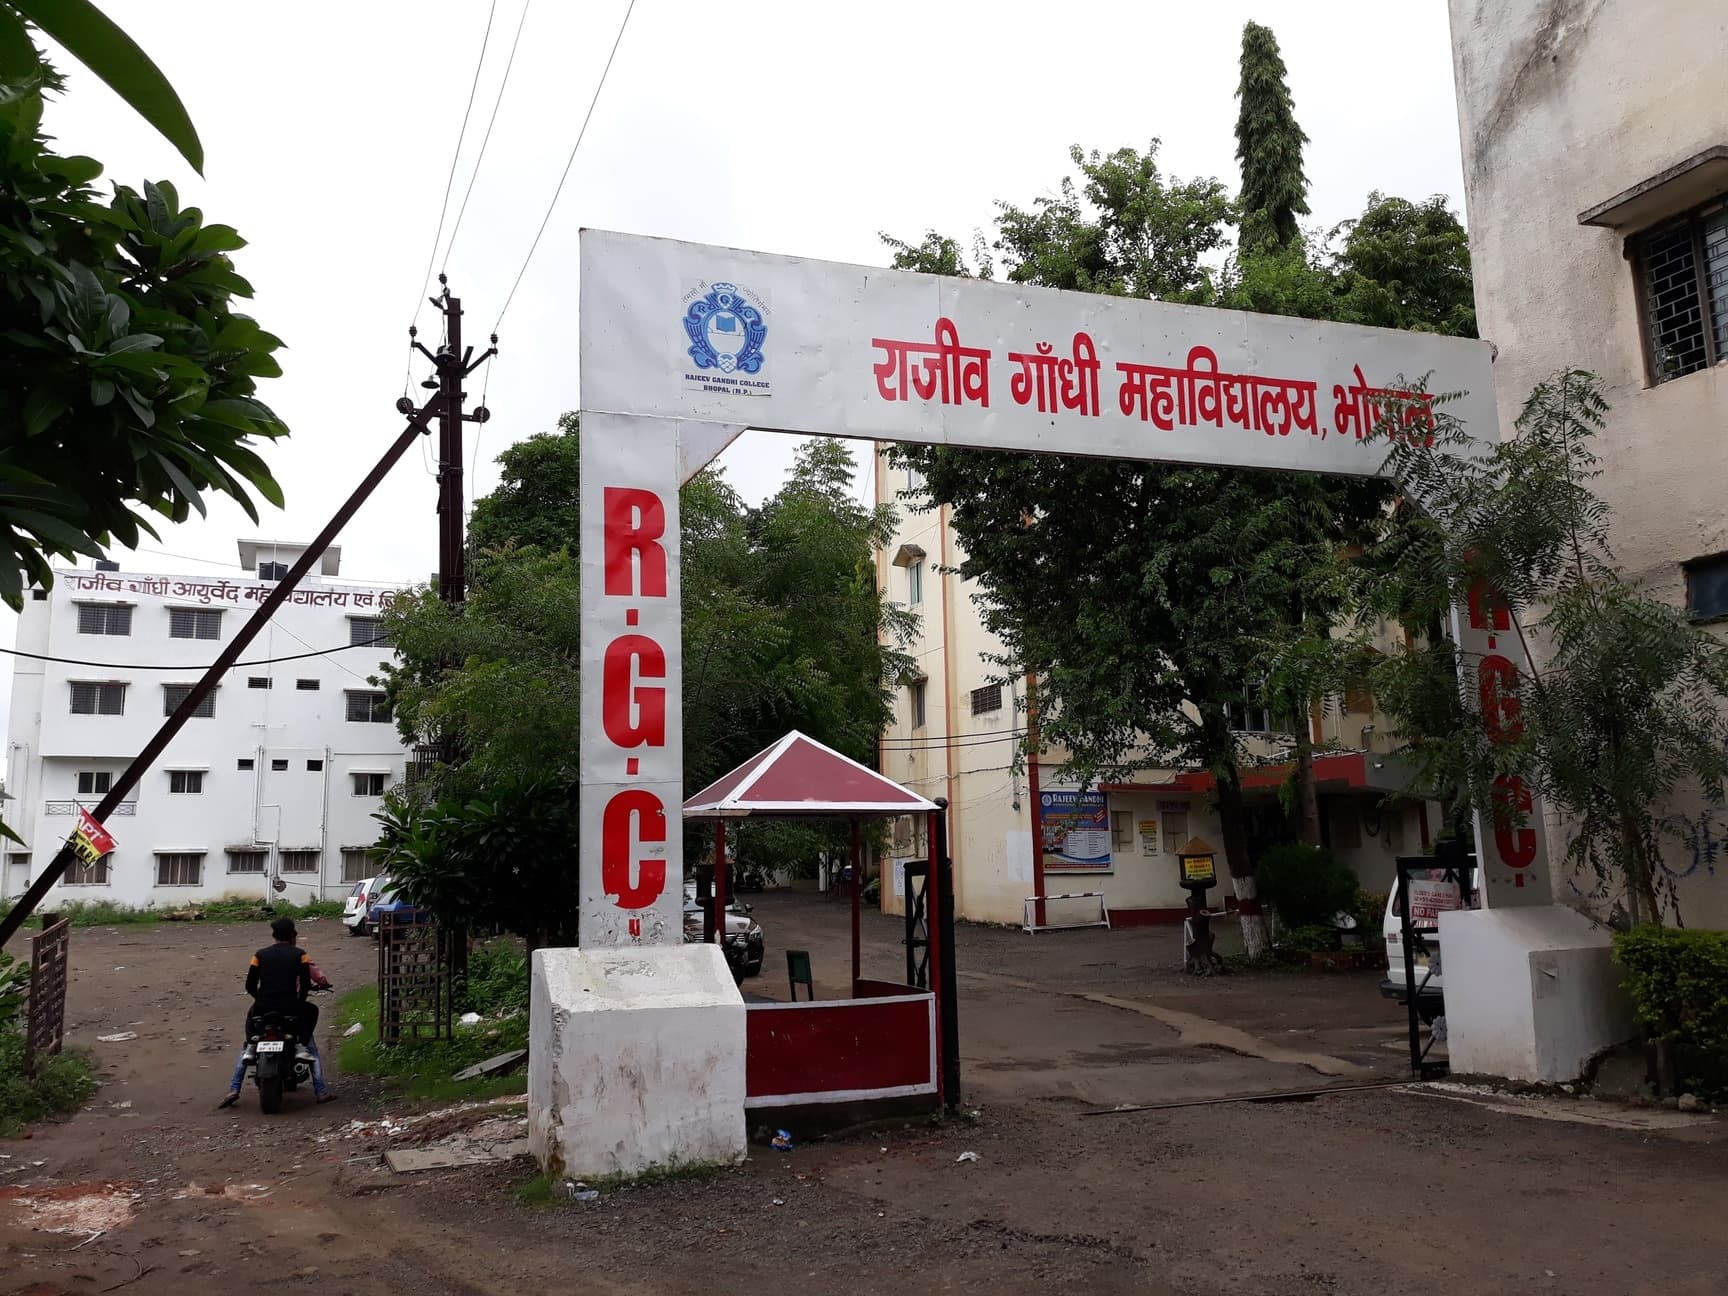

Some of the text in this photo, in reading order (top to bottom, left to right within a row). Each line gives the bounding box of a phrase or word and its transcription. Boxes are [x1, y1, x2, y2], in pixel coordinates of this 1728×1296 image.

[873, 318, 991, 407] राजीव
[1009, 333, 1100, 417] गाँधी
[685, 374, 770, 389] RAJEEV GANDHI COLLEGE
[703, 385, 730, 394] BHOPAL
[64, 573, 124, 594] राजीव
[172, 580, 240, 604] आयुर्वेद
